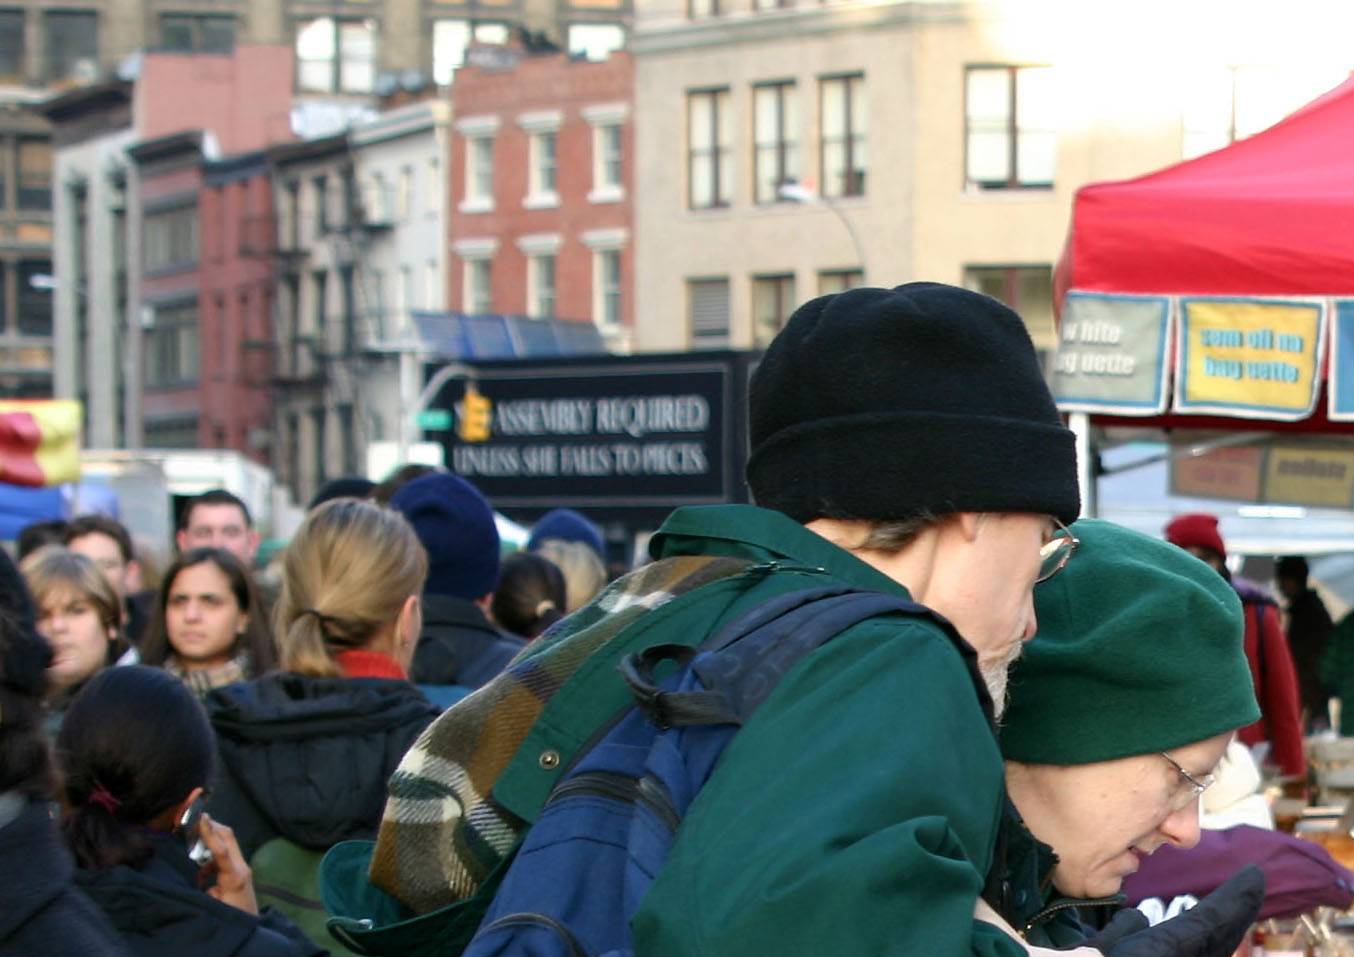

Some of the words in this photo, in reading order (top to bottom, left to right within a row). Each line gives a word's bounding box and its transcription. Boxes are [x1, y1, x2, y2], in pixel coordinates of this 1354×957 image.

[497, 399, 593, 435] ASSEMBLY
[597, 396, 711, 437] REQUIRED
[611, 443, 642, 476] TO
